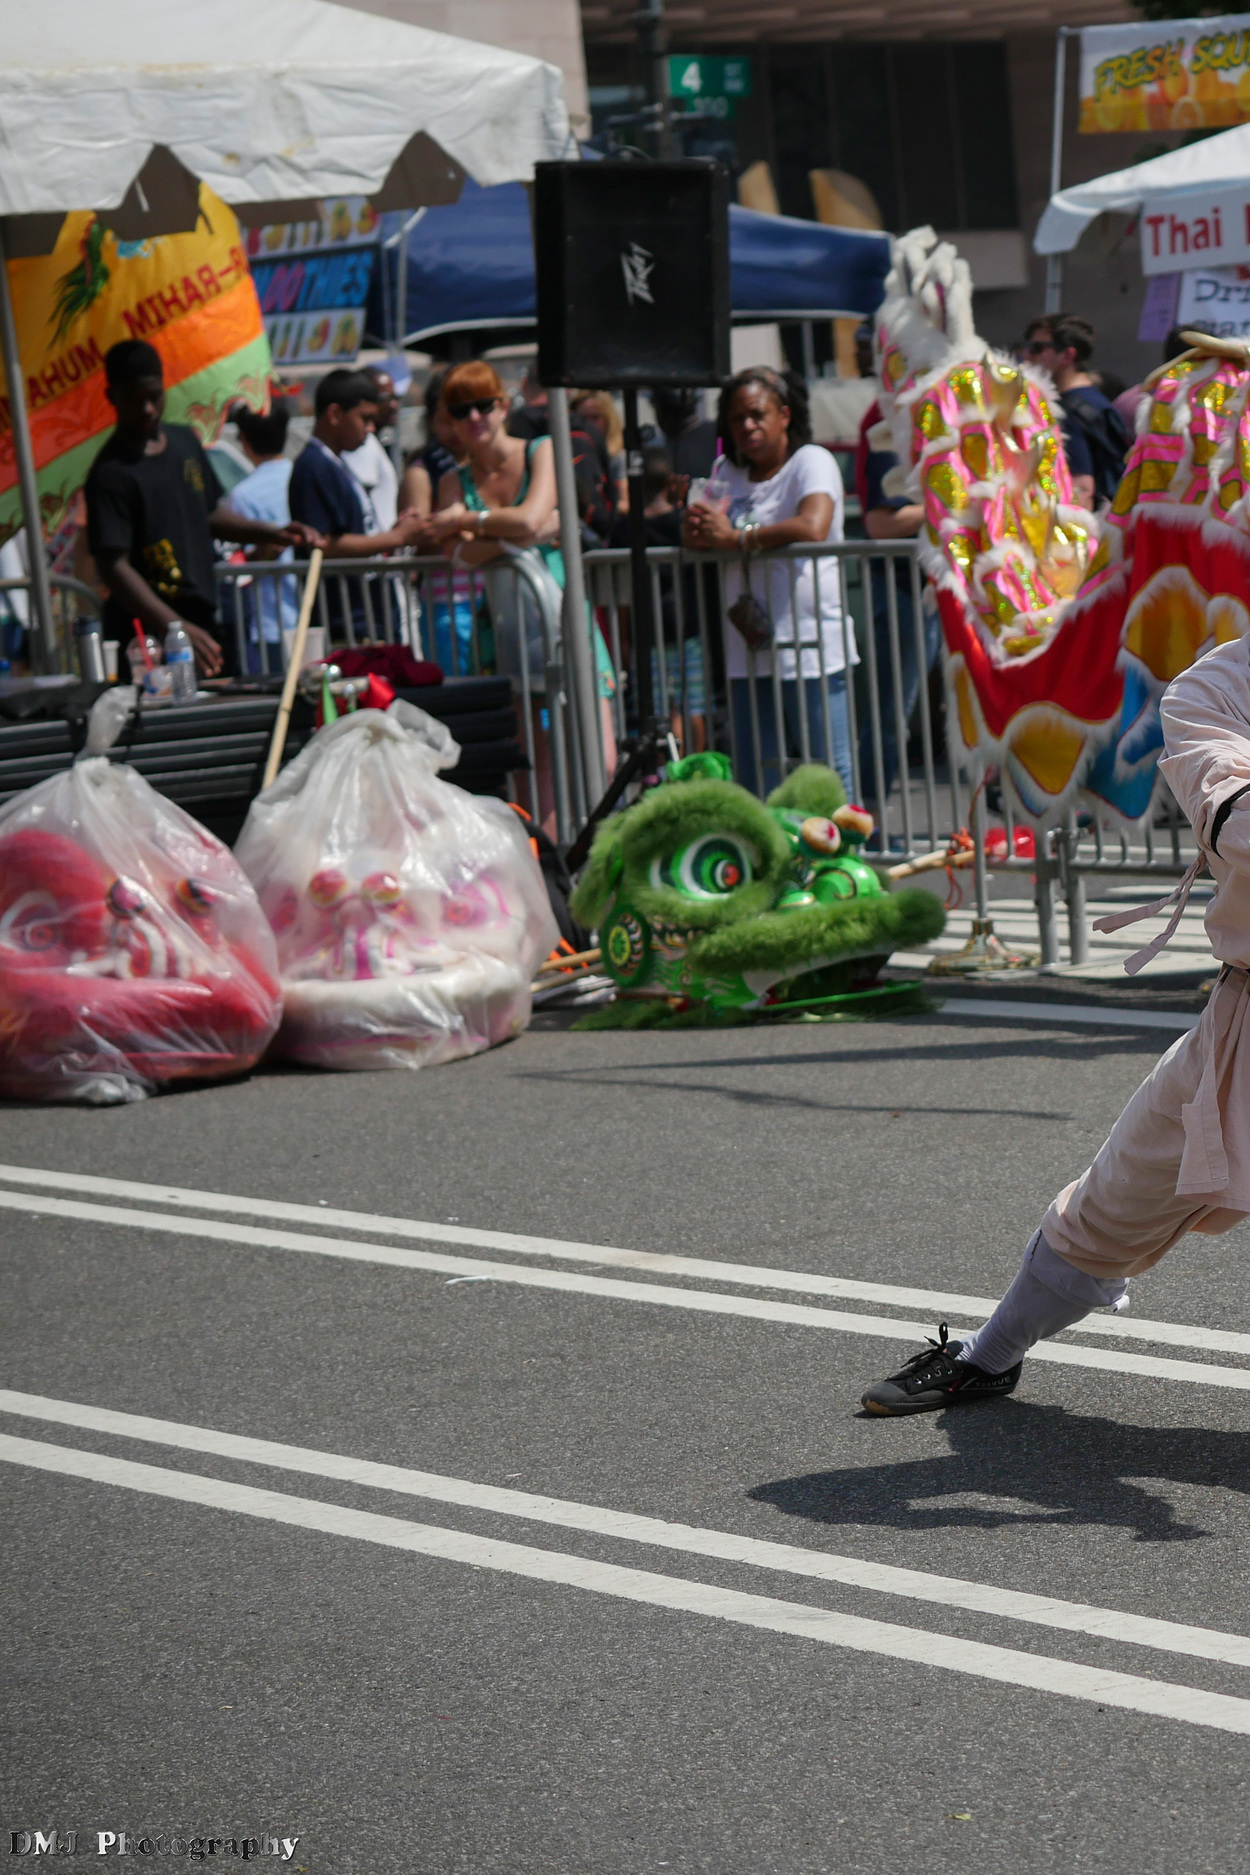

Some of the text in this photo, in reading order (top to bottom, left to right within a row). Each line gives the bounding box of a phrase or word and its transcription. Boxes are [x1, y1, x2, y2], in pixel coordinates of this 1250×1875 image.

[681, 62, 703, 93] 4
[1095, 38, 1186, 103] FRESH
[1145, 206, 1223, 257] Thai
